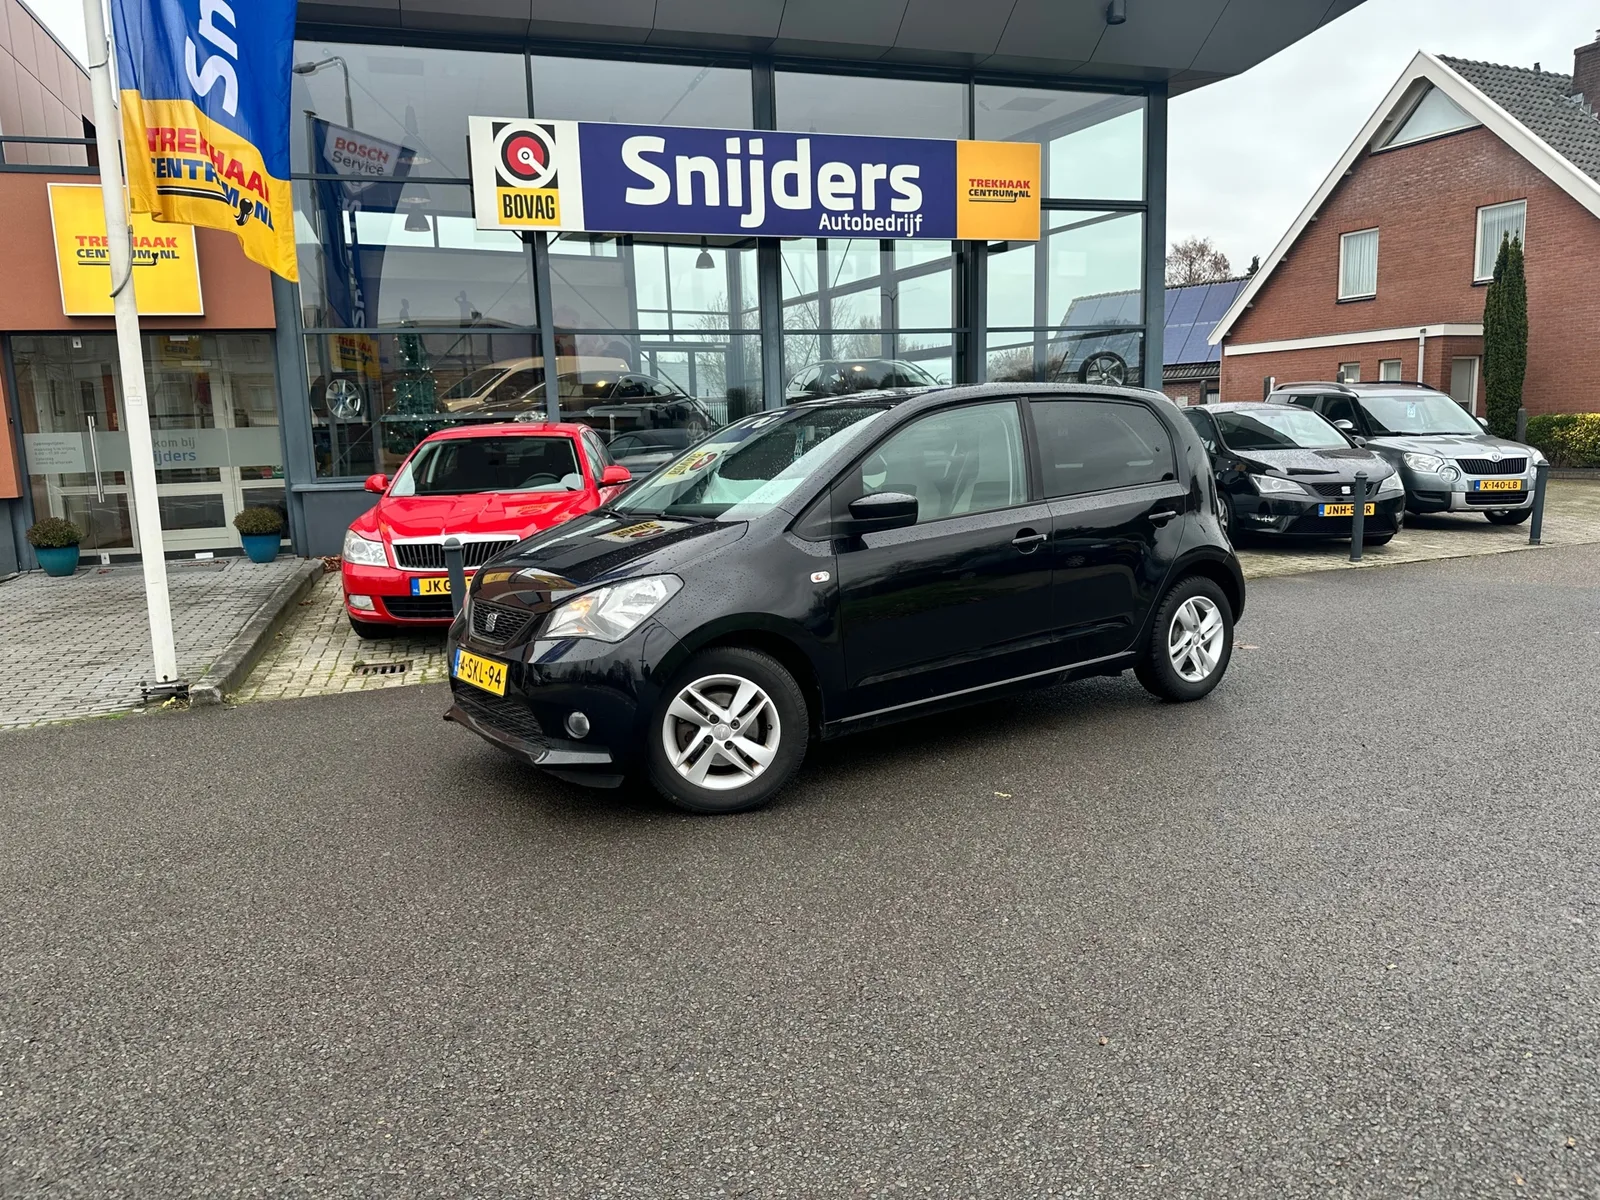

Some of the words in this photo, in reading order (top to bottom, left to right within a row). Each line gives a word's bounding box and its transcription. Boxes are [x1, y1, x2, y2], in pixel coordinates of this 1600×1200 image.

[334, 137, 390, 164] BOSCH
[331, 150, 385, 176] Service
[621, 135, 923, 228] Snijders
[969, 179, 1031, 189] TREKHAAK
[502, 194, 556, 220] BOVAG
[818, 213, 923, 237] Autobedrijf
[75, 235, 178, 248] TREAAK
[153, 438, 178, 448] kom
[181, 437, 196, 449] bij
[153, 450, 197, 466] ijders
[1483, 481, 1518, 489] X-140-LB
[1326, 505, 1372, 515] JNH-5R
